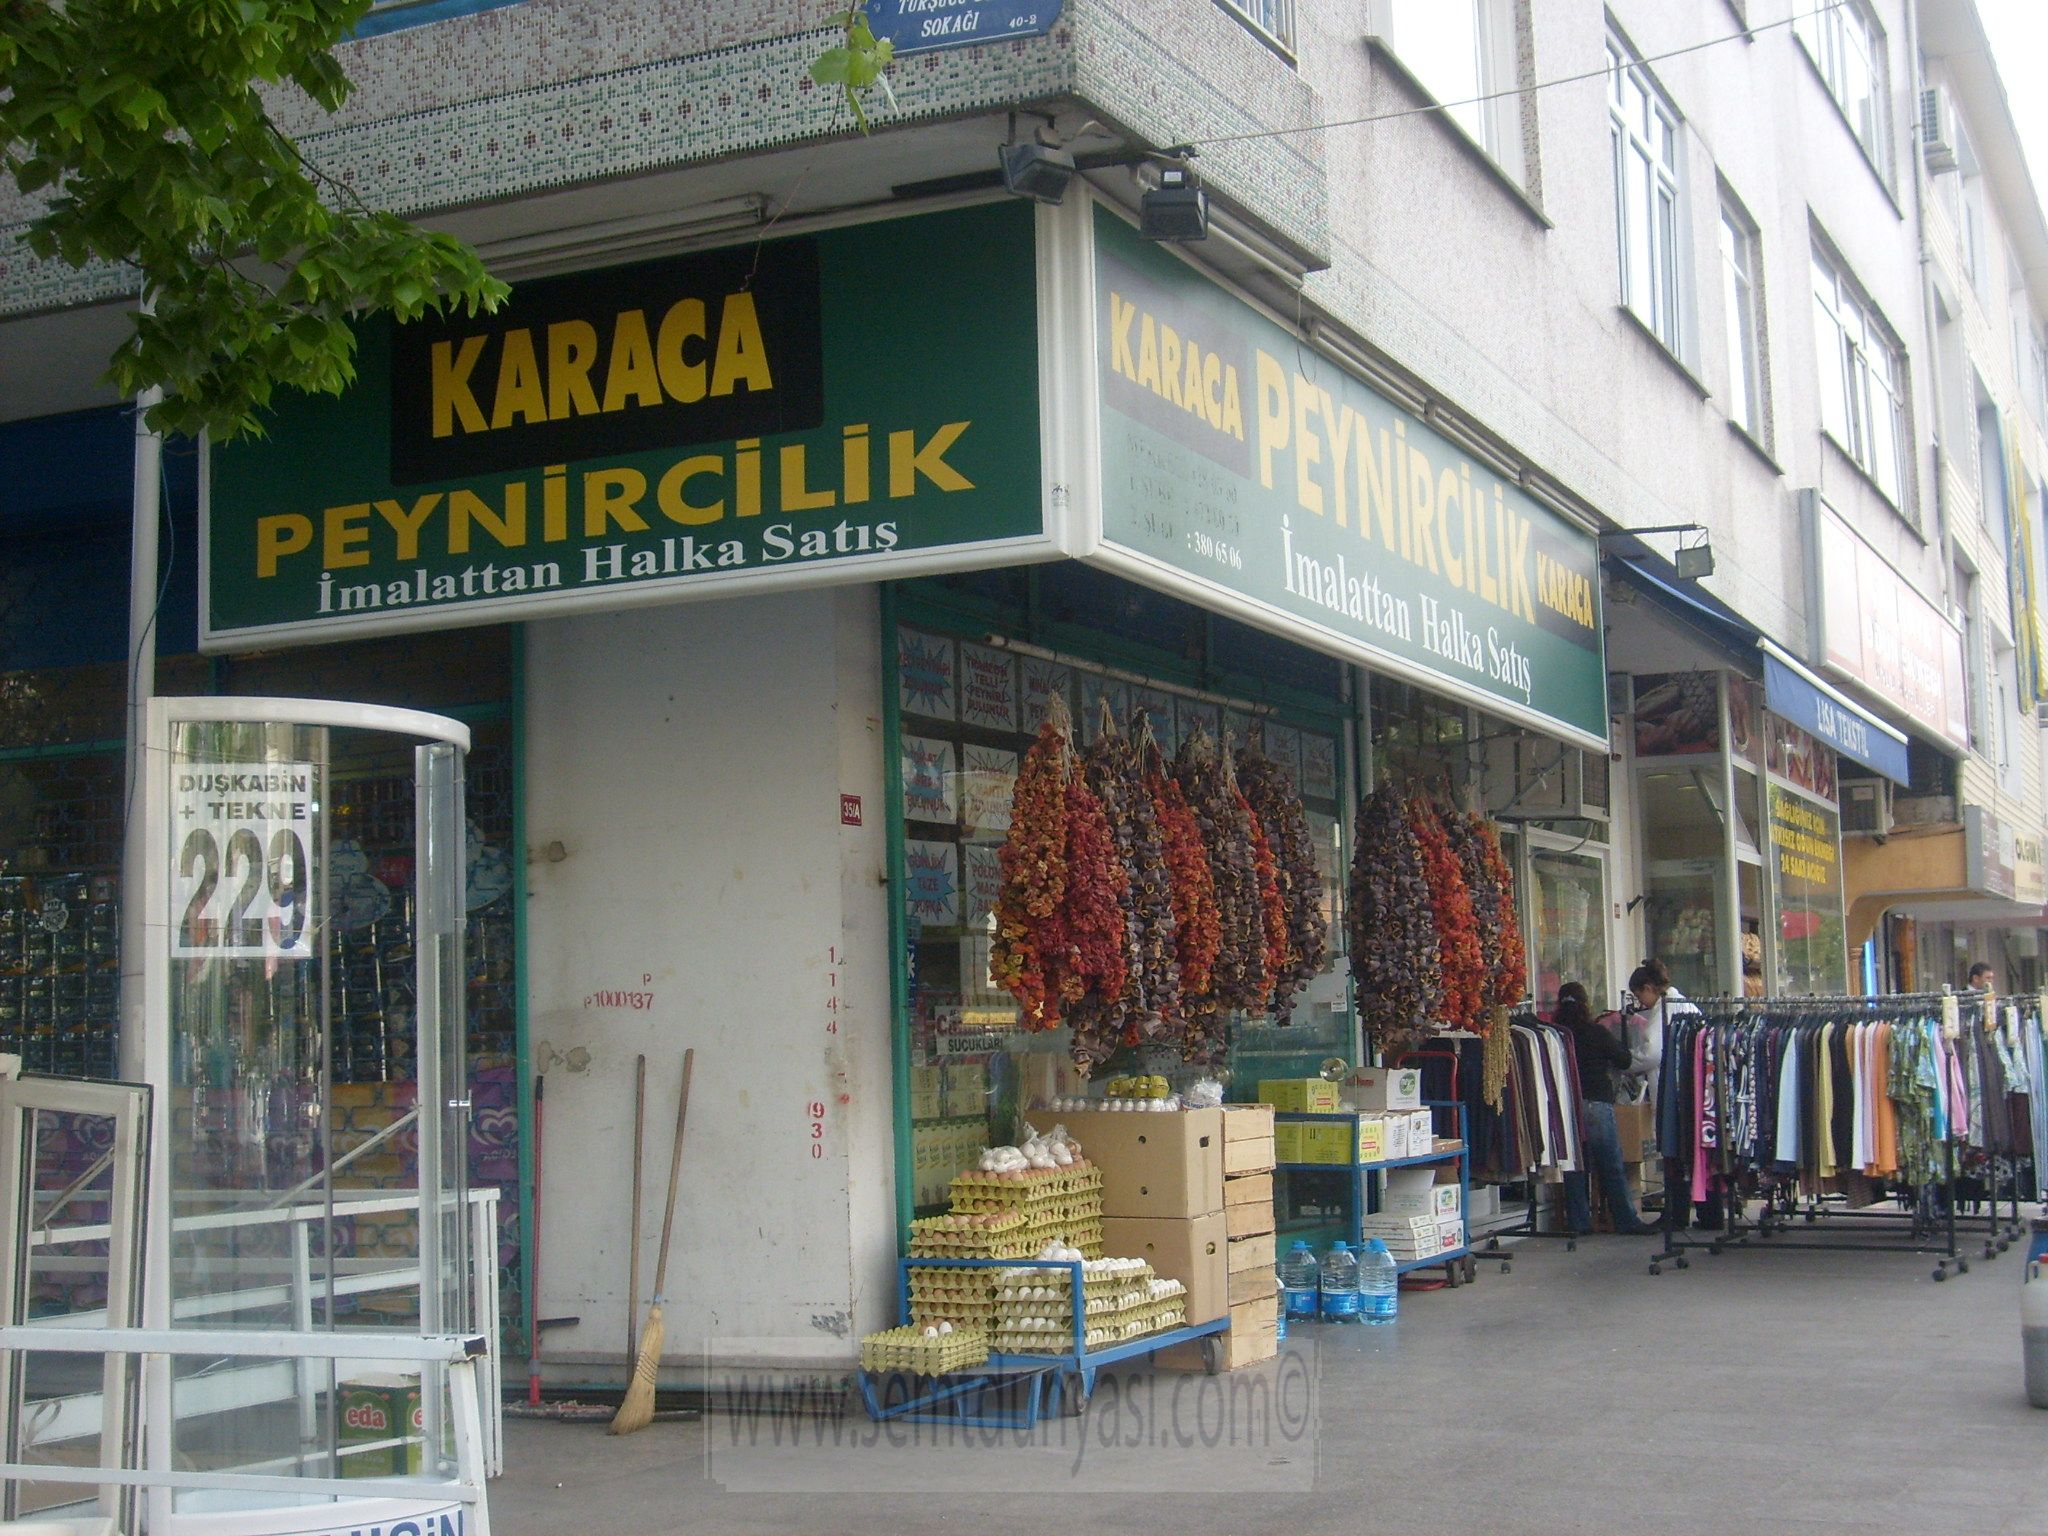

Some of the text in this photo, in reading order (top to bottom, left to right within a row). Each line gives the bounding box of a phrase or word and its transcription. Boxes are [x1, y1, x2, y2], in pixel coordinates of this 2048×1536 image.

[921, 10, 980, 37] SOKAĞI
[431, 291, 774, 440] KARACA
[1110, 291, 1244, 442] KARACA
[255, 420, 976, 579] PEYNİRCİLİK
[1256, 347, 1536, 624] PEYNİRCİLİK
[316, 513, 900, 614] İmalattan Halka Satış
[1194, 531, 1213, 558] 380
[1215, 541, 1227, 564] 65
[1229, 546, 1242, 570] 06
[1536, 551, 1595, 630] KARACA
[1281, 514, 1412, 641] İmalattan
[1420, 591, 1485, 674] Halka
[1487, 626, 1532, 705] Satış
[180, 770, 306, 796] DUŞKABİN
[208, 803, 306, 819] TEKNE
[179, 828, 307, 949] 229
[346, 1403, 387, 1430] eda
